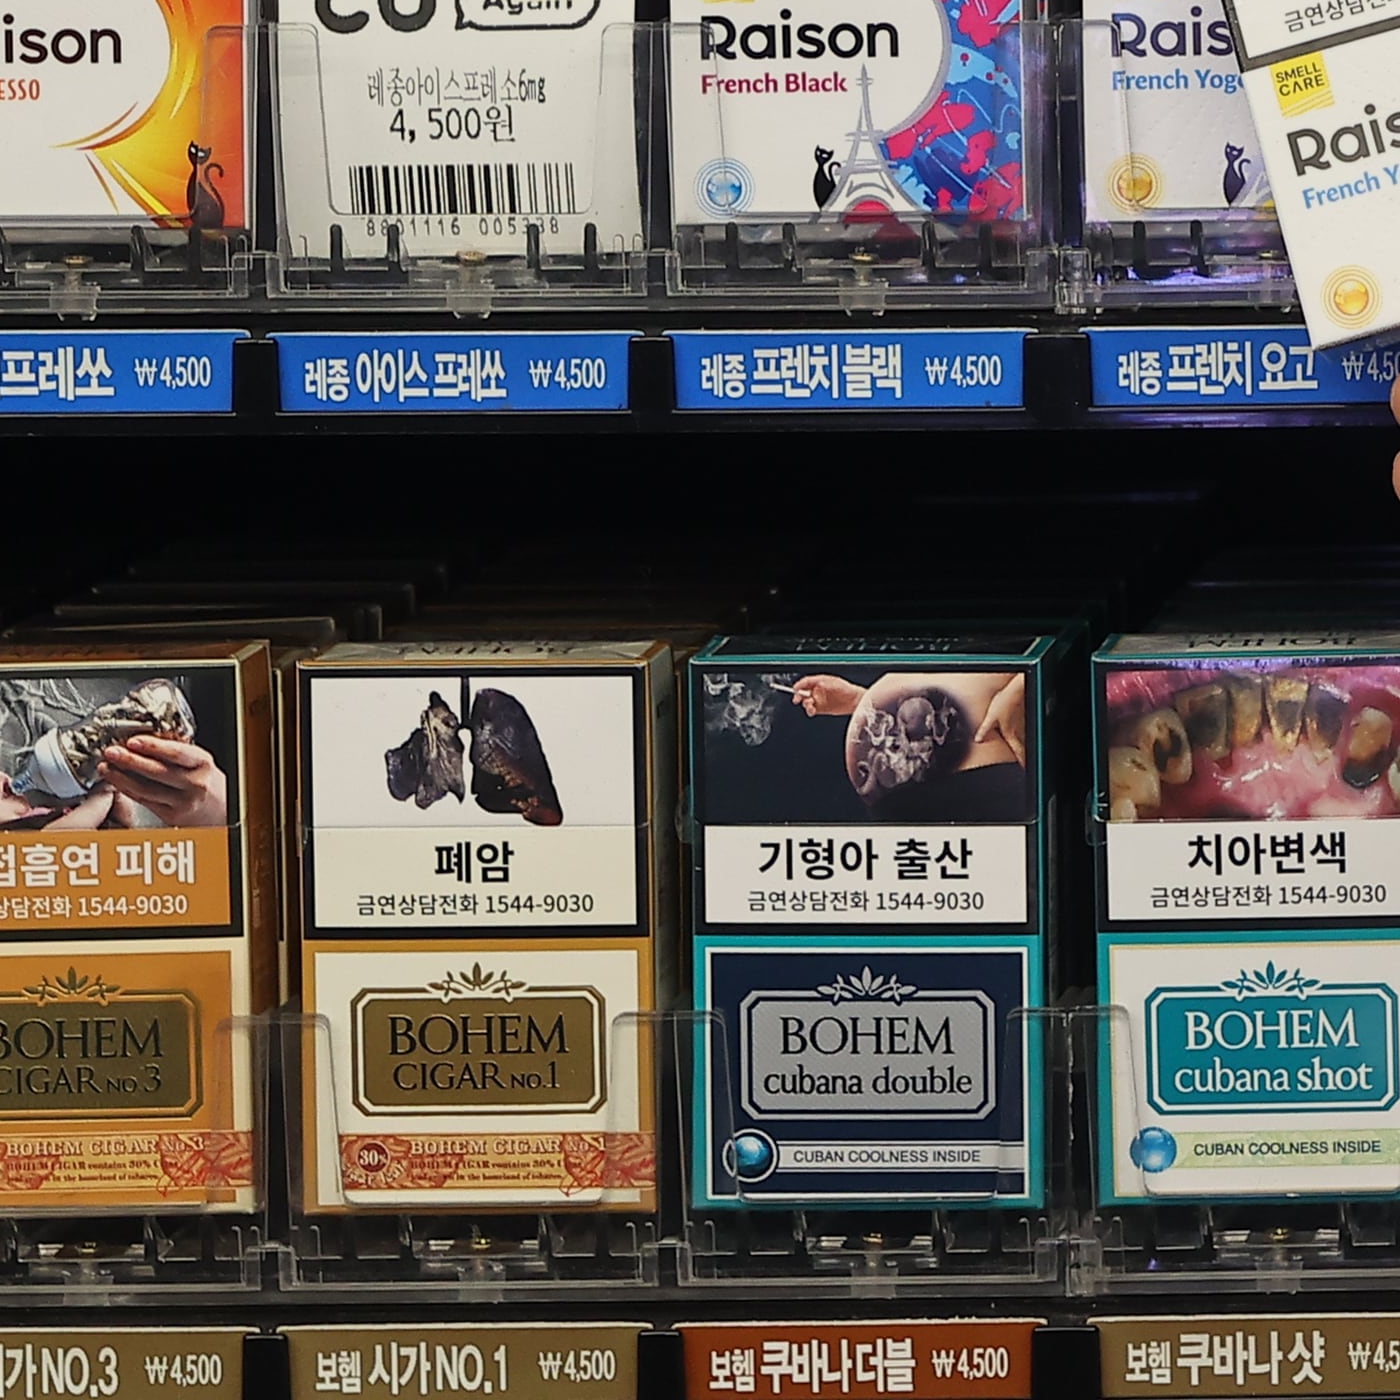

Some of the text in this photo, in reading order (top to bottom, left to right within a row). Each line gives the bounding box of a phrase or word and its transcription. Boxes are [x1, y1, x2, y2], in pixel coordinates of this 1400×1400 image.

[697, 9, 898, 60] Raison
[702, 71, 847, 94] French Black
[1275, 61, 1324, 85] SMELL
[1278, 72, 1325, 96] CARE
[1302, 170, 1380, 209] French
[135, 357, 210, 389] ₩4,500
[435, 841, 514, 883] 폐암
[1188, 832, 1345, 875] 치아변색
[780, 1017, 954, 1054] BOHEM
[764, 1065, 972, 1094] cubana double
[1175, 1057, 1372, 1092] cubana shot
[794, 1150, 980, 1163] CUBAN COOLNESS INSIDE
[1126, 1342, 1170, 1383] 보헴
[1177, 1331, 1283, 1385] 쿠바나
[1288, 1331, 1325, 1384] 샷
